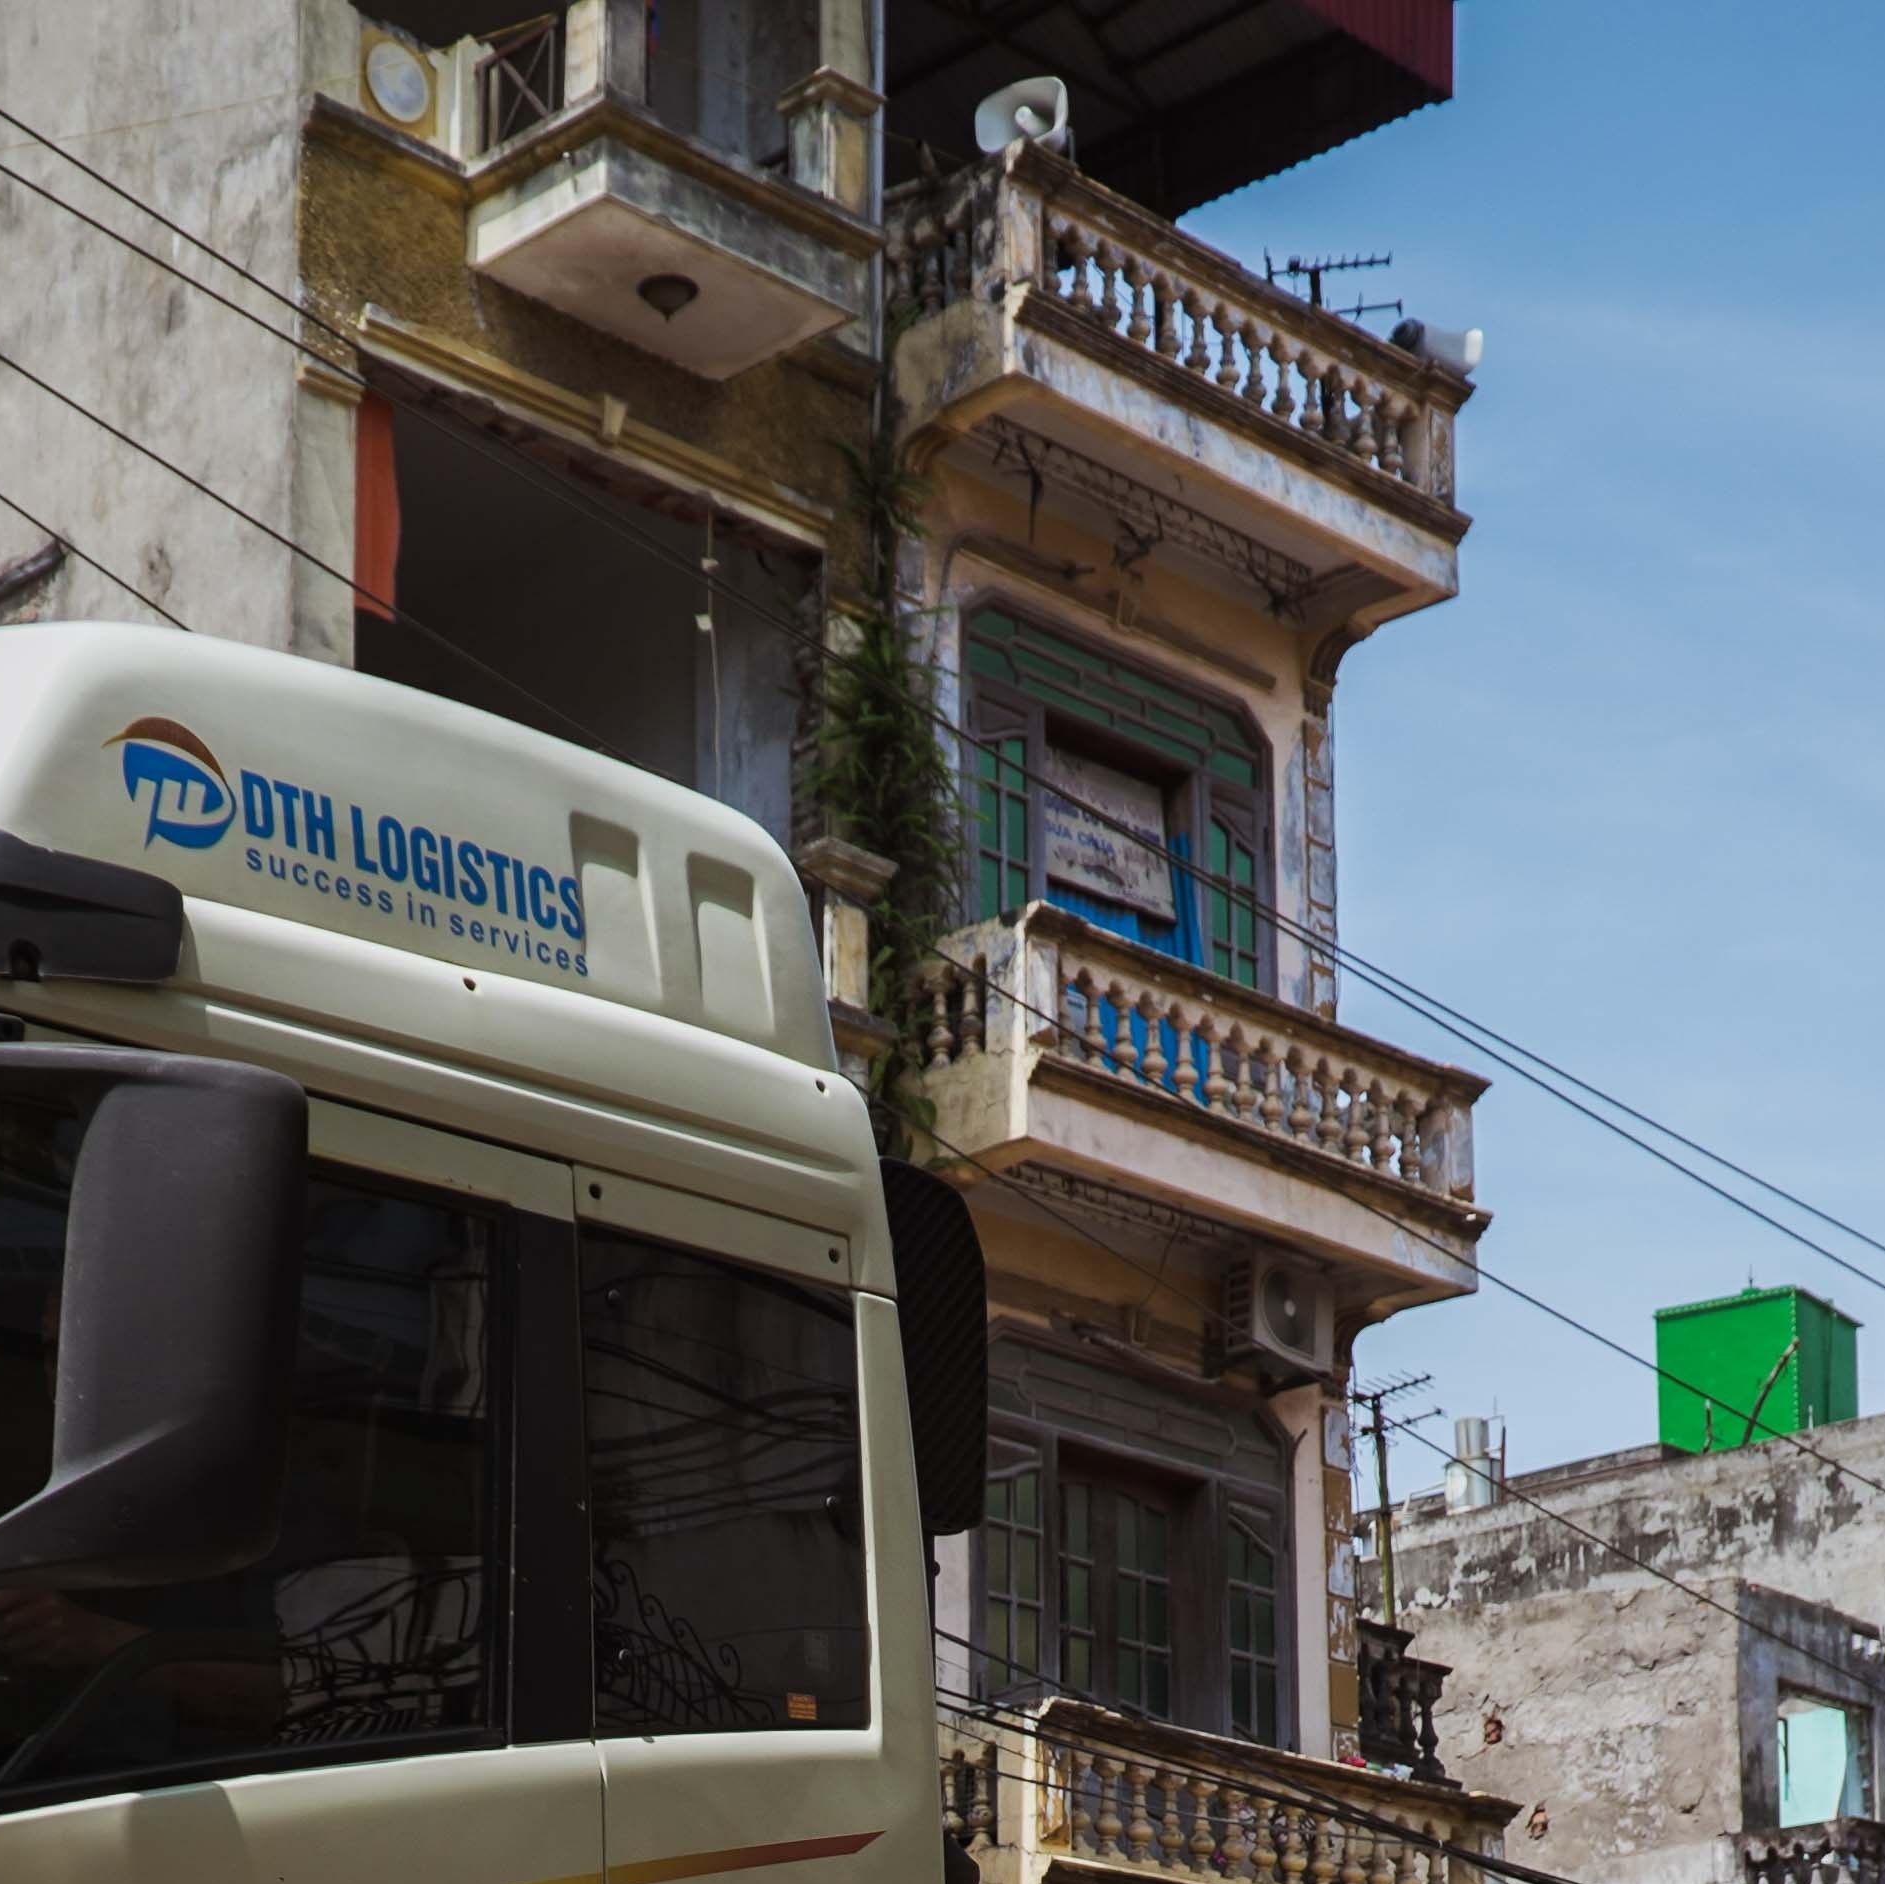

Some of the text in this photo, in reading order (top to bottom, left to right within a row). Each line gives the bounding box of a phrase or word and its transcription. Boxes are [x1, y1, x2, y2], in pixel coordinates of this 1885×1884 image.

[240, 769, 586, 941] DTH LOGISTICS
[246, 847, 589, 976] success in services
